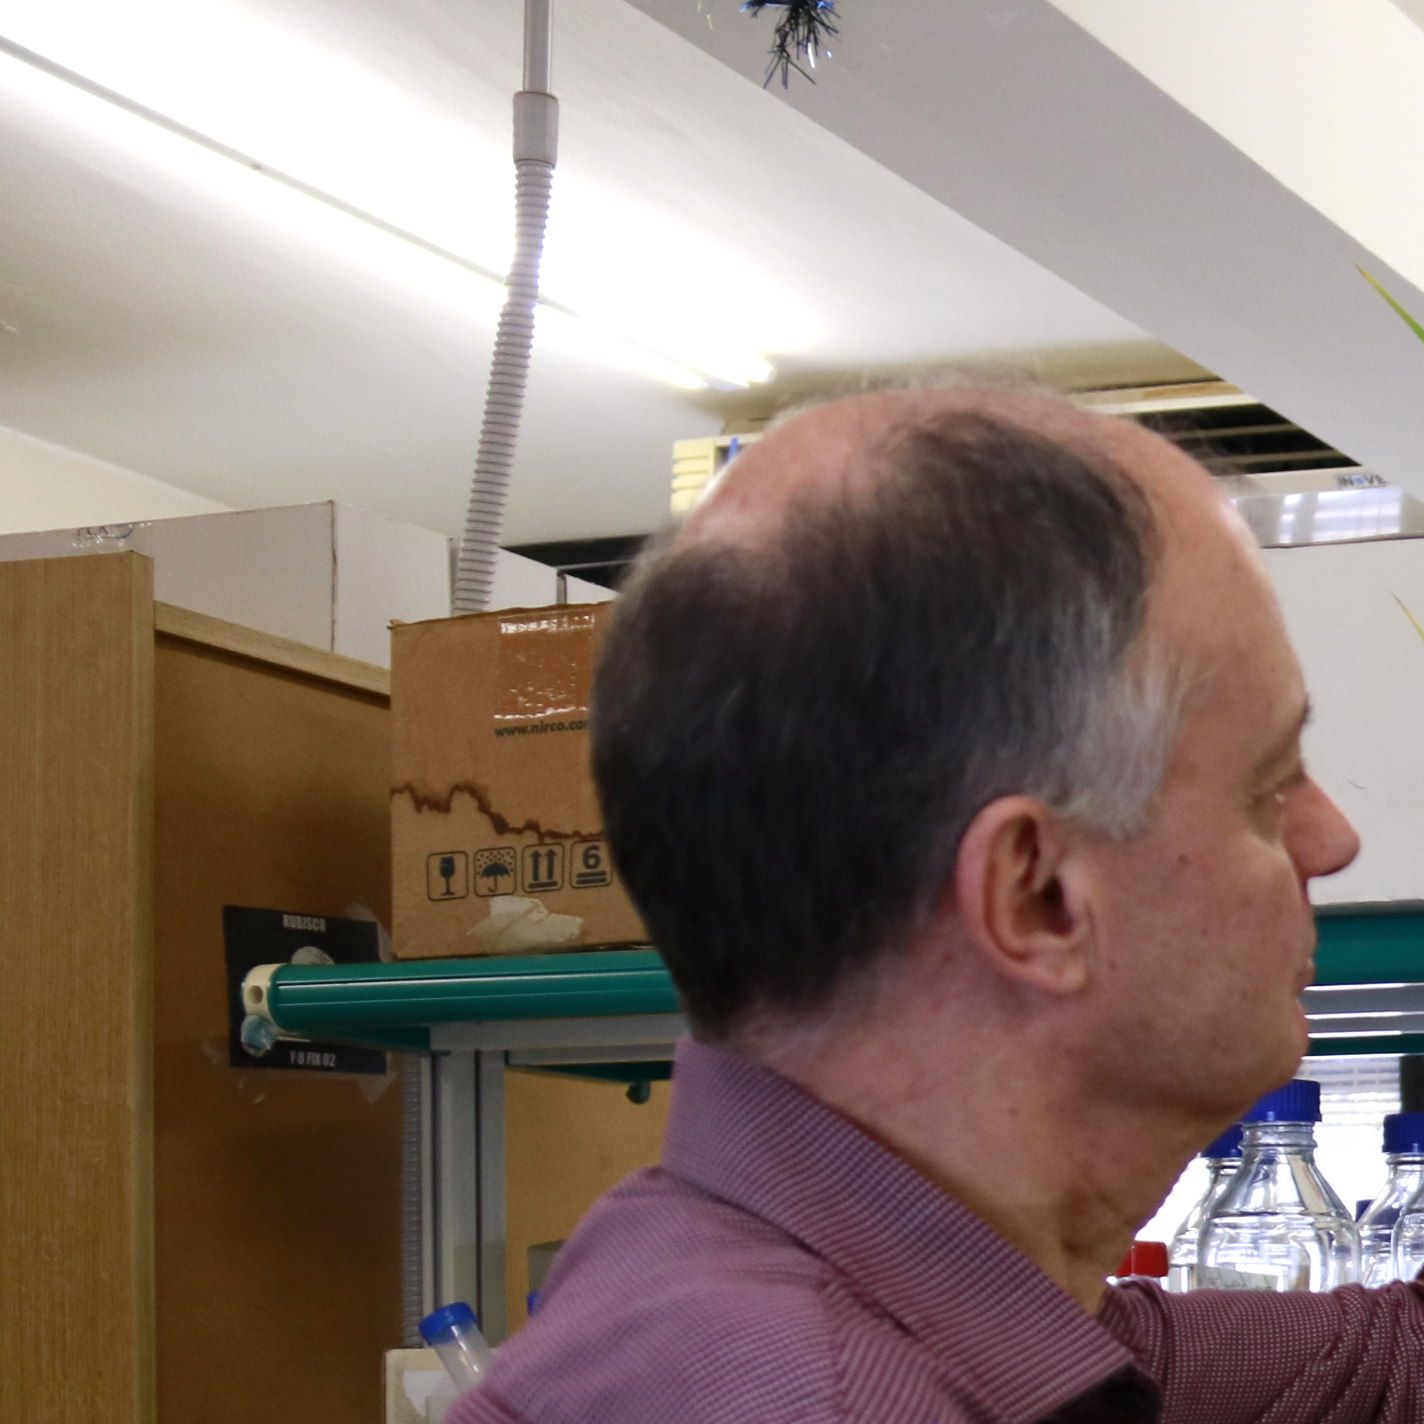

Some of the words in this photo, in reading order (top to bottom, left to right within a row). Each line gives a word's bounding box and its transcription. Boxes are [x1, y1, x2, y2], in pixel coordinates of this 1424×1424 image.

[583, 844, 601, 870] 6
[283, 914, 326, 932] RUBISCO
[306, 1053, 322, 1066] FIX
